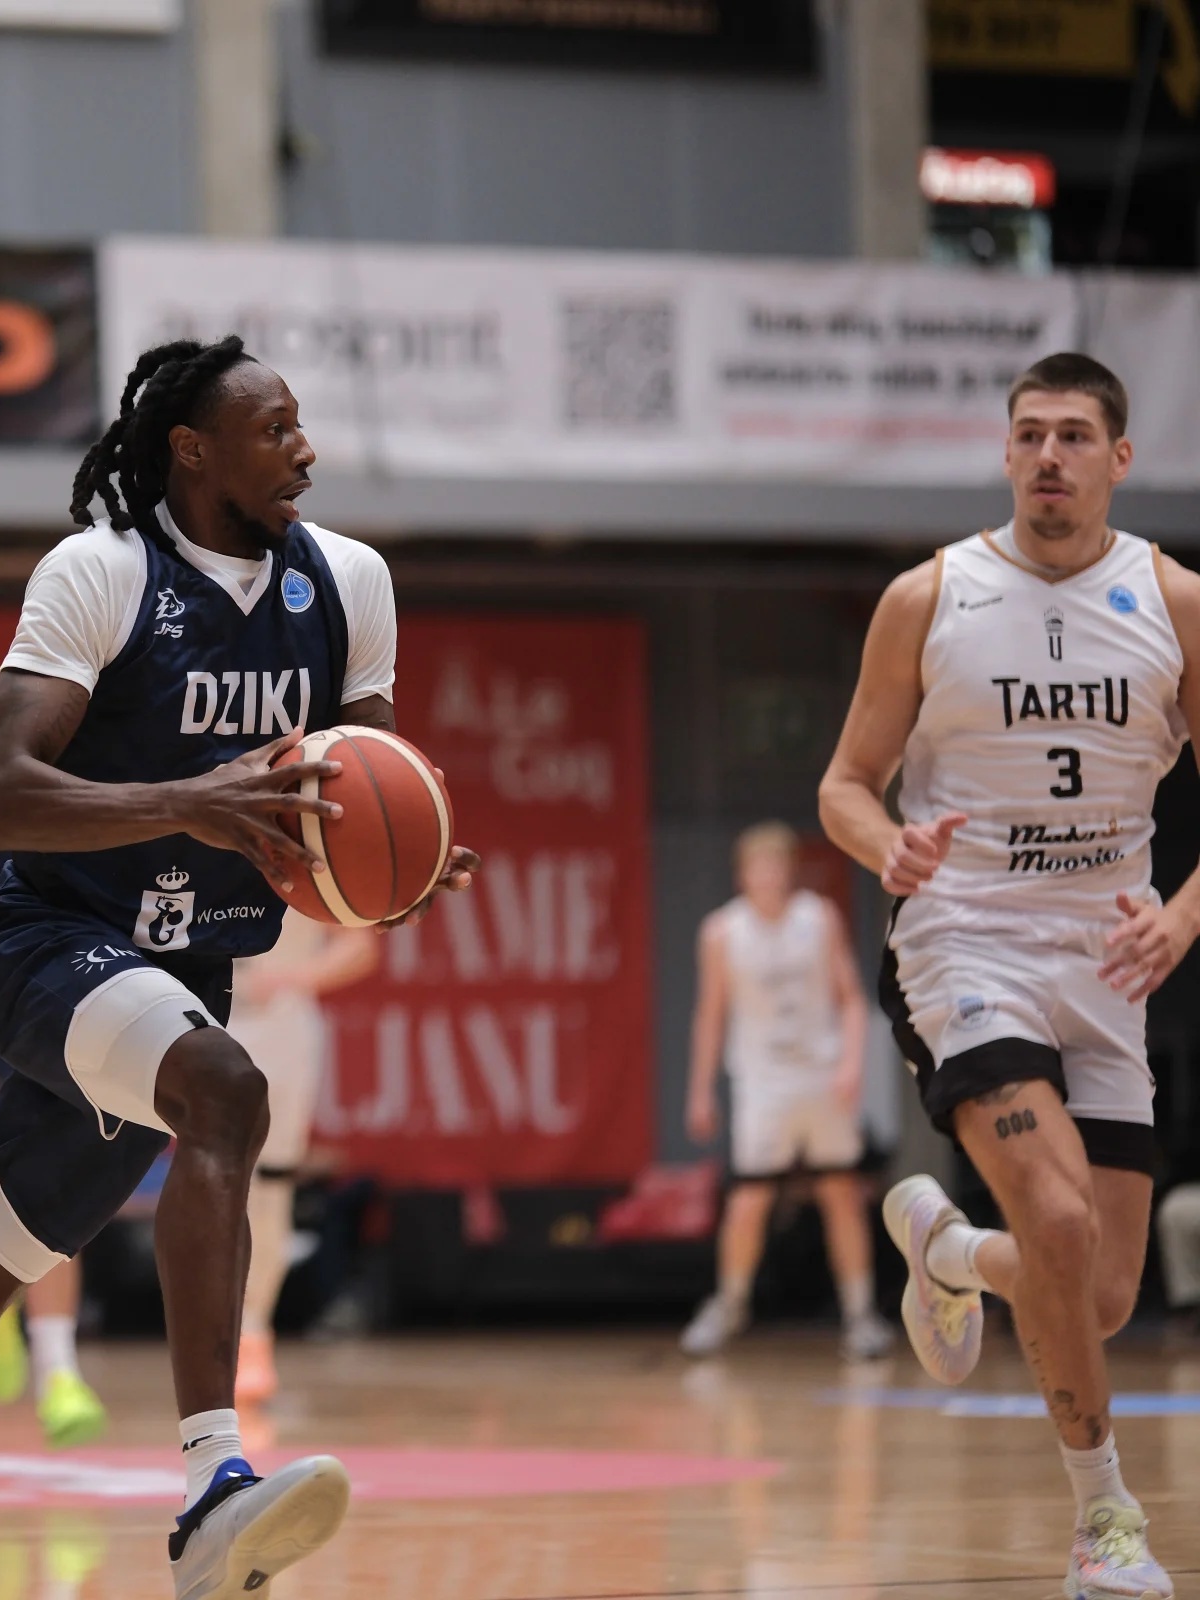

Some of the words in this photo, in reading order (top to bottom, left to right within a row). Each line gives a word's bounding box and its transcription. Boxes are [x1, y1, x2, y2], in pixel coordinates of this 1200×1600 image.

[179, 667, 311, 737] DZIKI
[991, 676, 1129, 729] TARTU
[1047, 747, 1083, 799] 3
[196, 905, 266, 925] Warsaw
